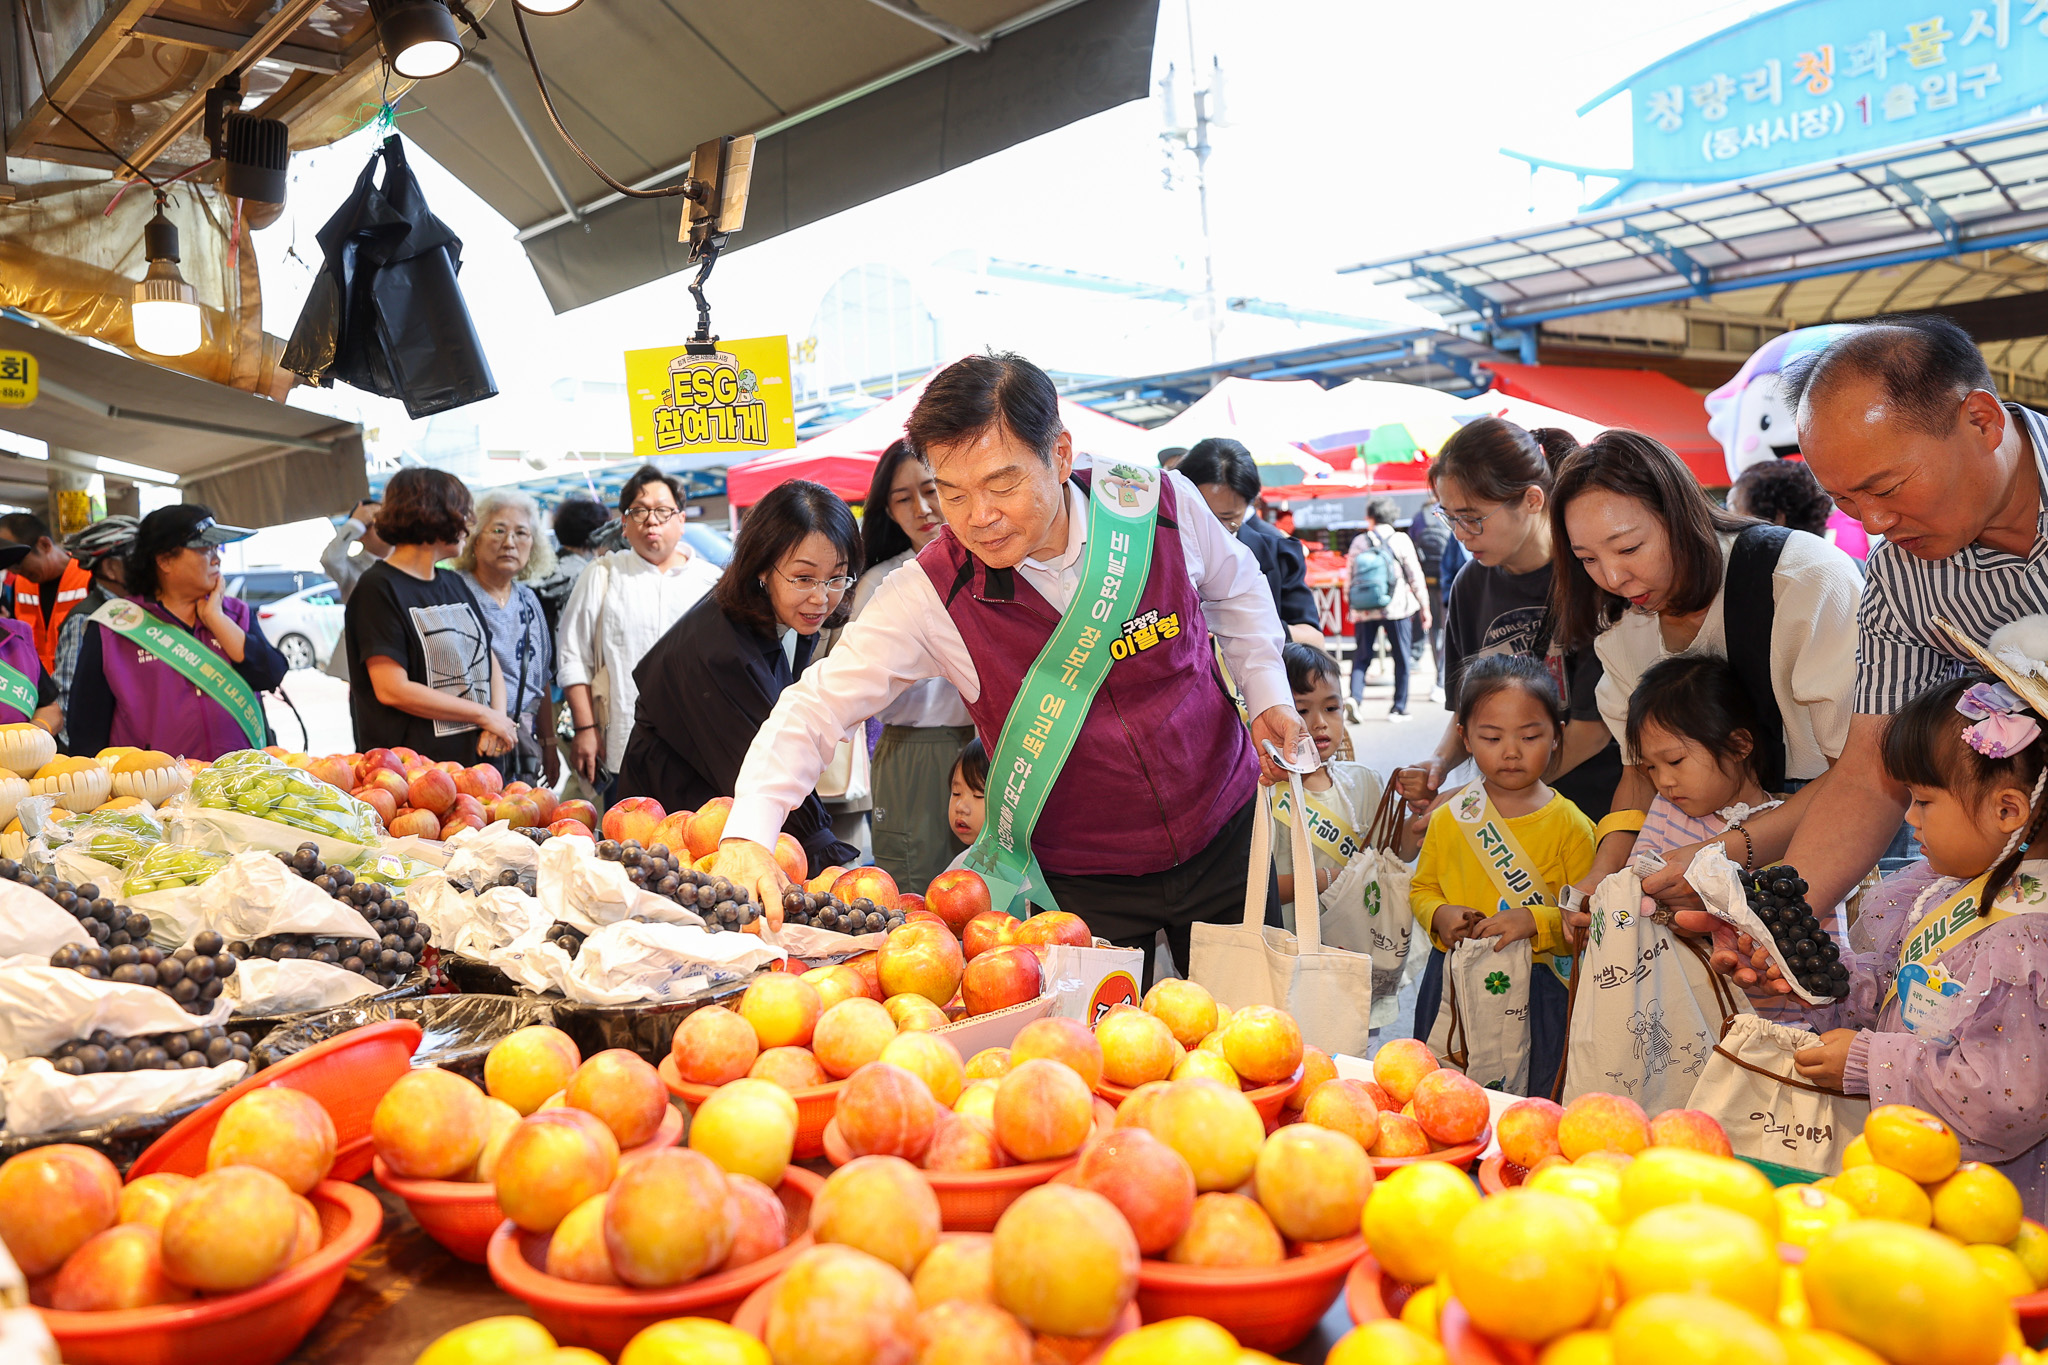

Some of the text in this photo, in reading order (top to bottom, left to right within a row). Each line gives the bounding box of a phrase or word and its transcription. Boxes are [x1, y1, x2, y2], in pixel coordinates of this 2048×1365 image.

[1646, 58, 1782, 132] 청량리
[1701, 61, 2002, 162] (동서시장) 1 출입구
[671, 367, 738, 407] ESG
[655, 403, 767, 450] 참여가게
[1091, 531, 1130, 623] 비닐없이
[1109, 612, 1181, 661] 이필형
[1122, 609, 1159, 635] 구청장
[1060, 625, 1102, 691] 장보기,
[1022, 693, 1066, 760] 에코백
[1004, 756, 1033, 810] 하나면
[1474, 819, 1534, 895] 지구는
[1905, 896, 1980, 963] 에코백
